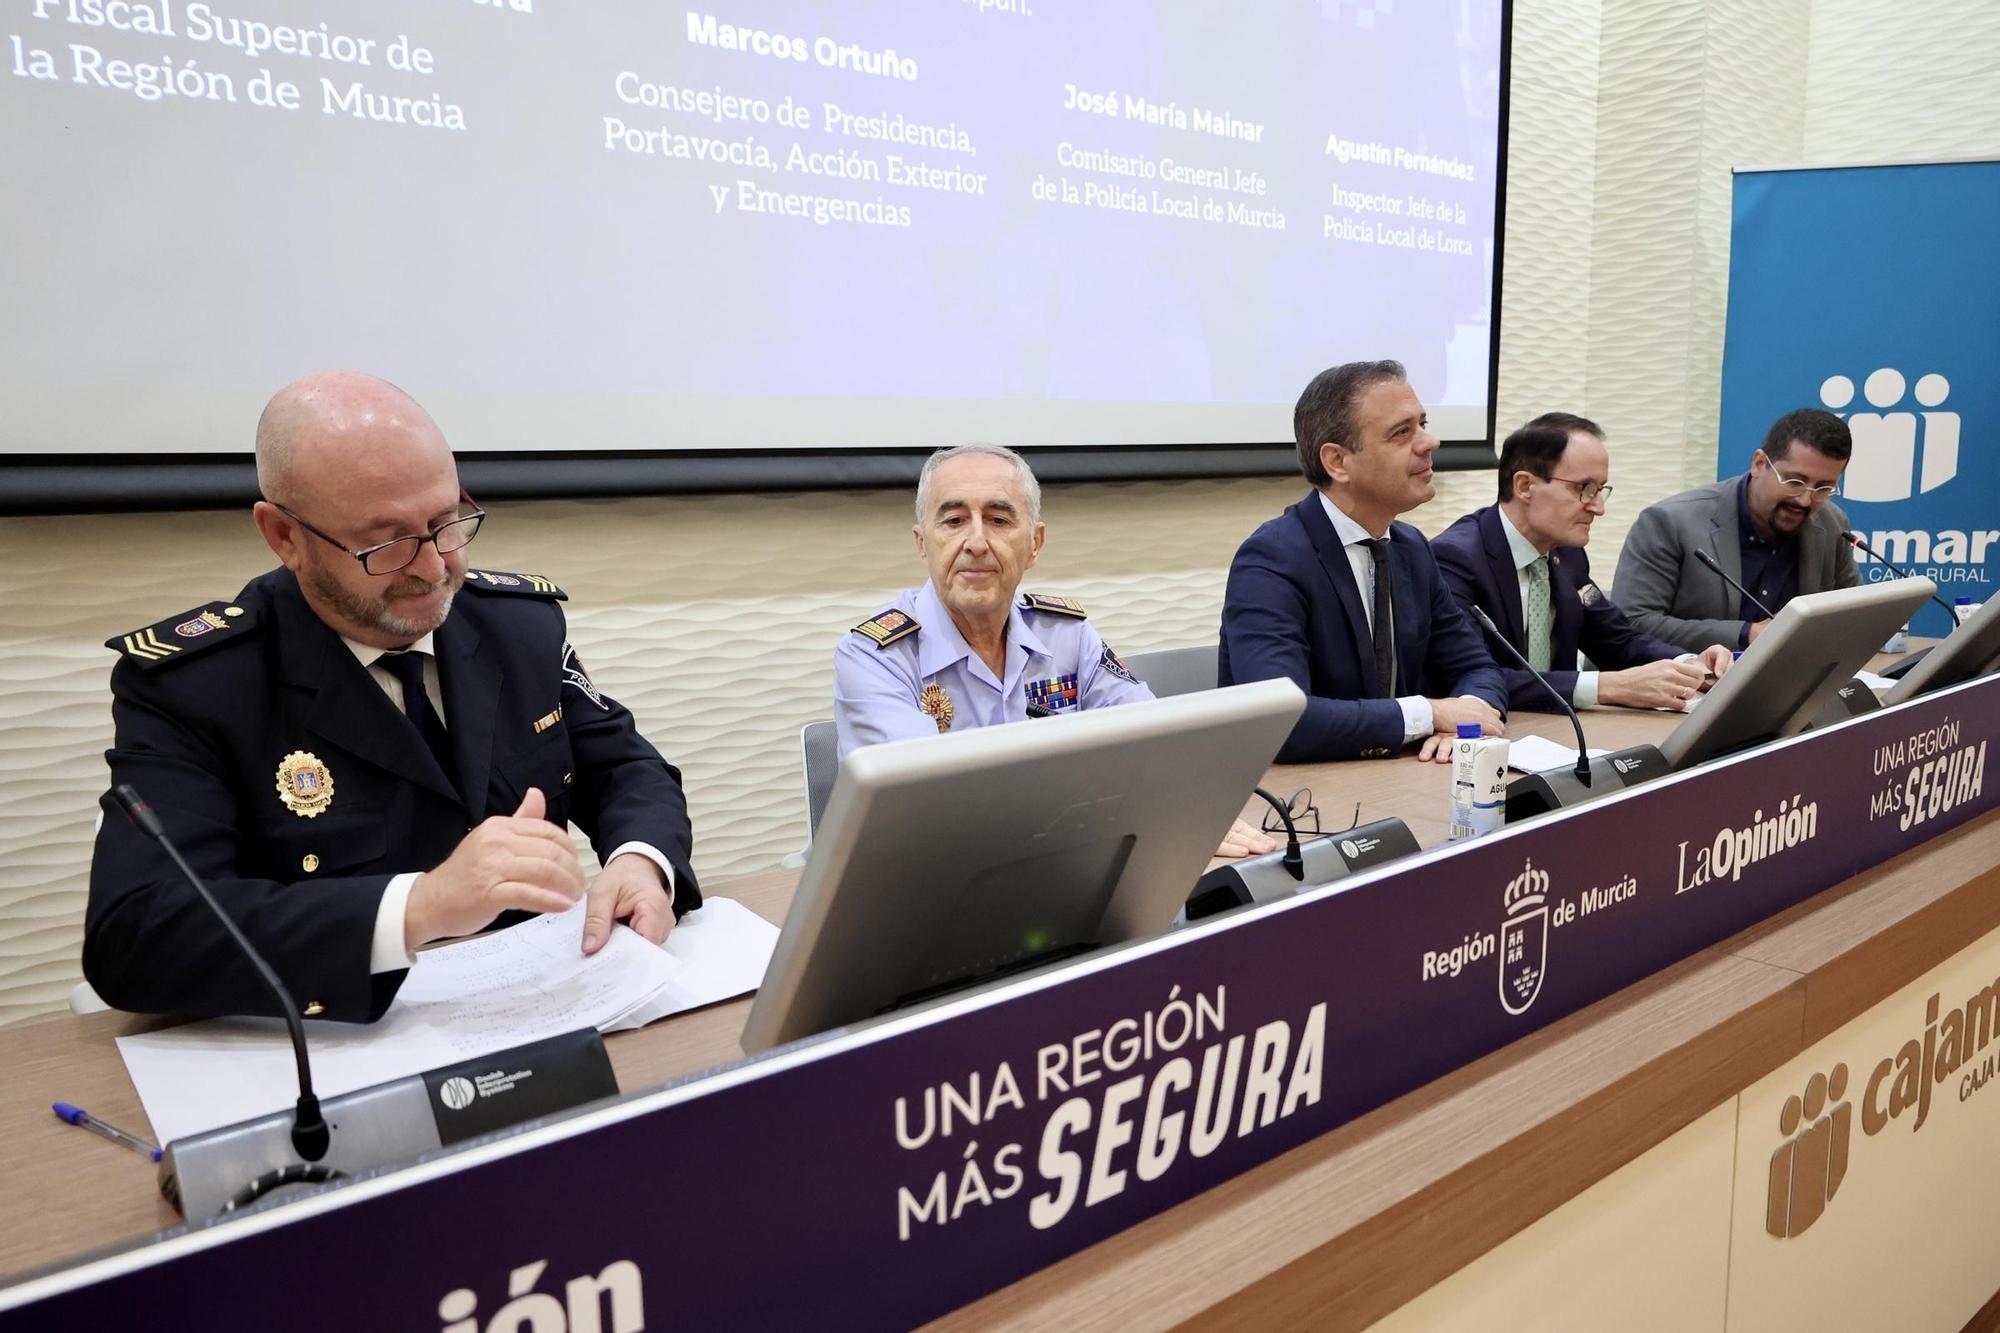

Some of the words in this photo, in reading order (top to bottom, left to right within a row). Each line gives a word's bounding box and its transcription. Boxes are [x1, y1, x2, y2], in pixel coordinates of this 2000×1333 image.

[187, 3, 376, 65] Superior
[387, 35, 433, 73] de
[687, 12, 808, 61] Marcos
[815, 37, 917, 80] Ortuño
[9, 35, 58, 80] la
[69, 44, 237, 102] Región
[248, 69, 300, 109] de
[320, 78, 466, 130] Murcia
[616, 72, 769, 122] Consejero
[777, 96, 810, 128] de
[823, 104, 976, 156] Presidencia,
[1064, 84, 1118, 116] José
[1126, 96, 1186, 129] María
[1194, 108, 1264, 142] Mainar
[603, 117, 777, 172] Portavocía,
[785, 144, 880, 181] Acción
[887, 156, 987, 194] Exterior
[1058, 142, 1155, 178] Comisario
[1160, 158, 1228, 189] General
[1233, 170, 1265, 195] Jefe
[1326, 134, 1391, 165] Agustín
[1395, 147, 1474, 181] Fernández
[709, 185, 729, 213] y
[737, 181, 911, 226] Emergencias
[1032, 175, 1056, 200] de
[1062, 178, 1079, 203] la
[1085, 182, 1147, 212] Policía
[1152, 191, 1199, 218] Local
[1203, 198, 1223, 222] de
[1228, 202, 1285, 229] Murcia
[1333, 184, 1402, 214] Inspector
[1406, 196, 1434, 219] Jefe
[1437, 201, 1452, 222] de
[1455, 202, 1467, 225] la
[1325, 216, 1373, 242] Policía
[1378, 223, 1415, 247] Local
[1418, 229, 1434, 250] de
[1438, 232, 1472, 255] Lorca
[1926, 568, 1991, 583] RURAL
[1874, 741, 1904, 775] UNA
[1908, 717, 1960, 762] REGIÓN
[1871, 779, 1901, 820] MÁS
[1901, 741, 1986, 831] SEGURA
[1423, 932, 1494, 980] Región
[1553, 899, 1575, 927] de
[1581, 875, 1636, 916] Murcia
[896, 1062, 1024, 1149] UNA
[1038, 985, 1224, 1099] REGIÓN
[1960, 1056, 1994, 1102] CAJA
[899, 1142, 1023, 1240] MÁS
[1030, 1003, 1326, 1229] SEGURA
